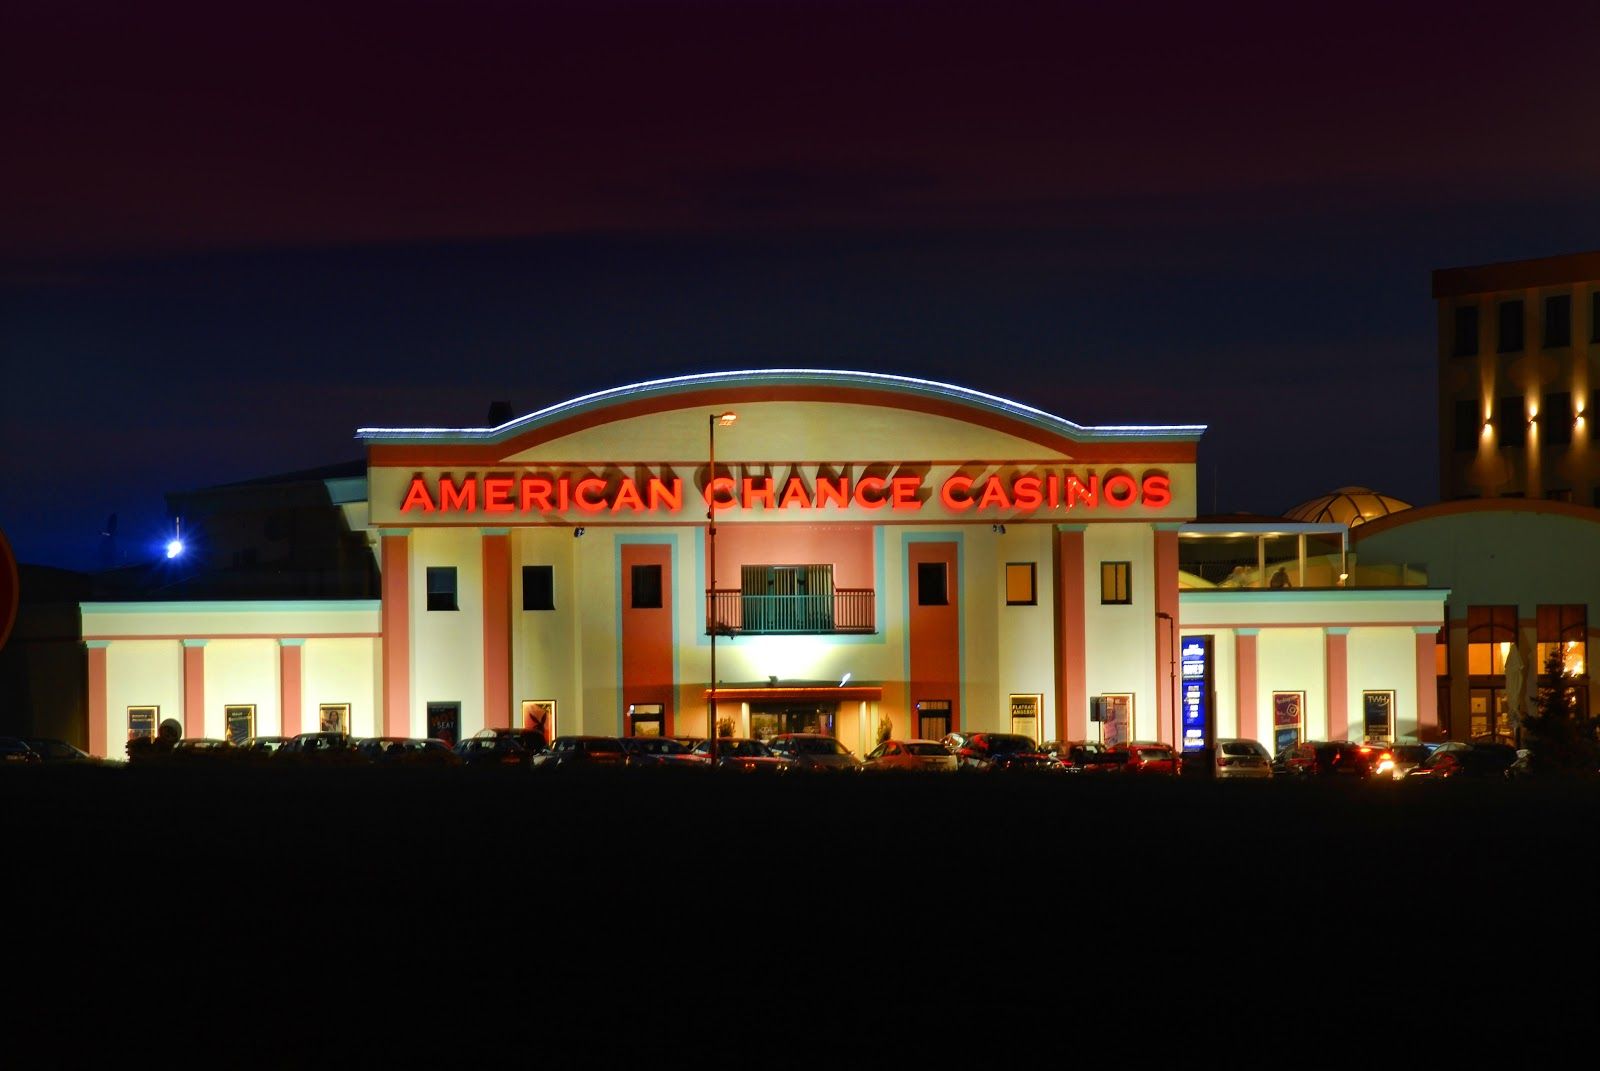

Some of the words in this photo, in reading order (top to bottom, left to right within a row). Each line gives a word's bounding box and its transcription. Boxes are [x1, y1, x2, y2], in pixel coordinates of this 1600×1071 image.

[400, 478, 683, 513] AMERICAN
[703, 476, 922, 511] CHANCE
[940, 475, 1172, 511] CASINOS
